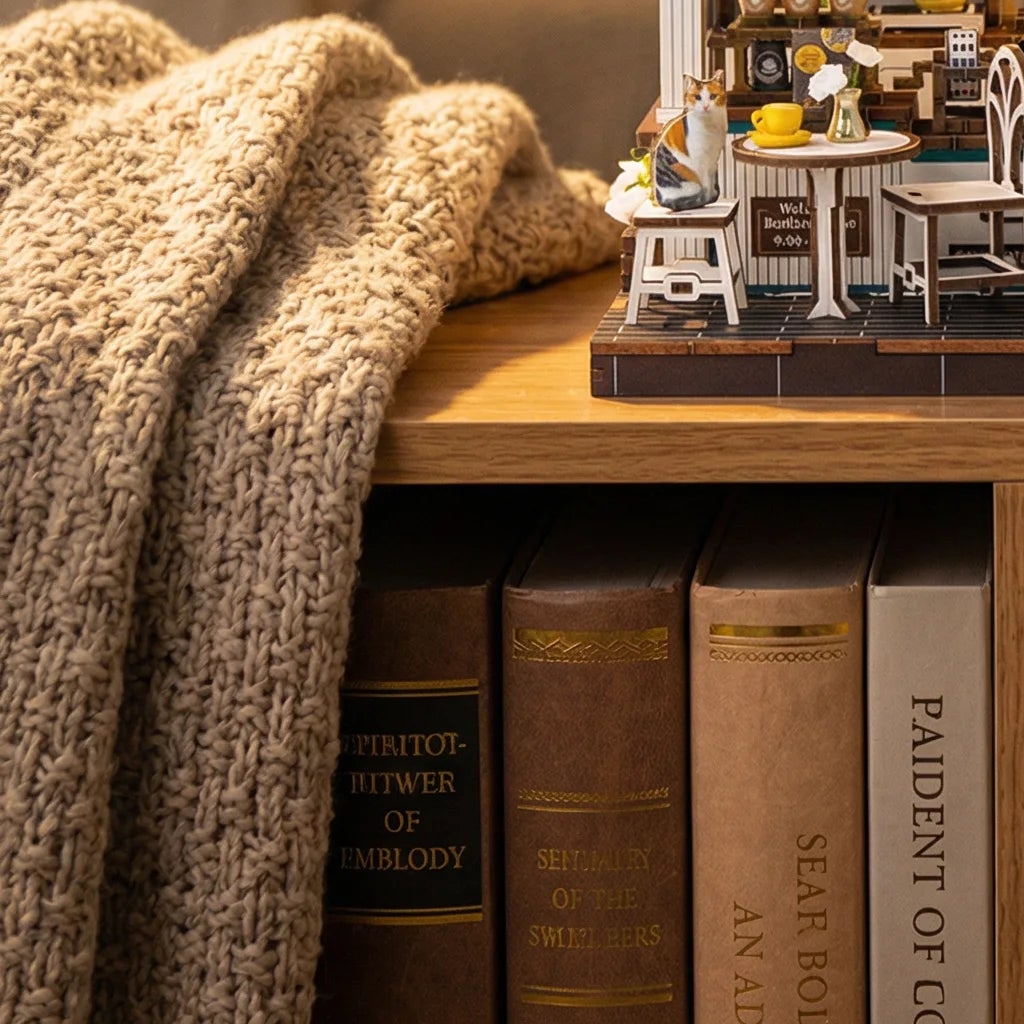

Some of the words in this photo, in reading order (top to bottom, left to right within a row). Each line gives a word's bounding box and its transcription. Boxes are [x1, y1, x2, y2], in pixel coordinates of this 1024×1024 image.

[384, 810, 420, 832] OF
[552, 888, 582, 909] OF
[796, 834, 828, 935] SEAR
[734, 901, 764, 960] AN
[912, 907, 945, 964] OF
